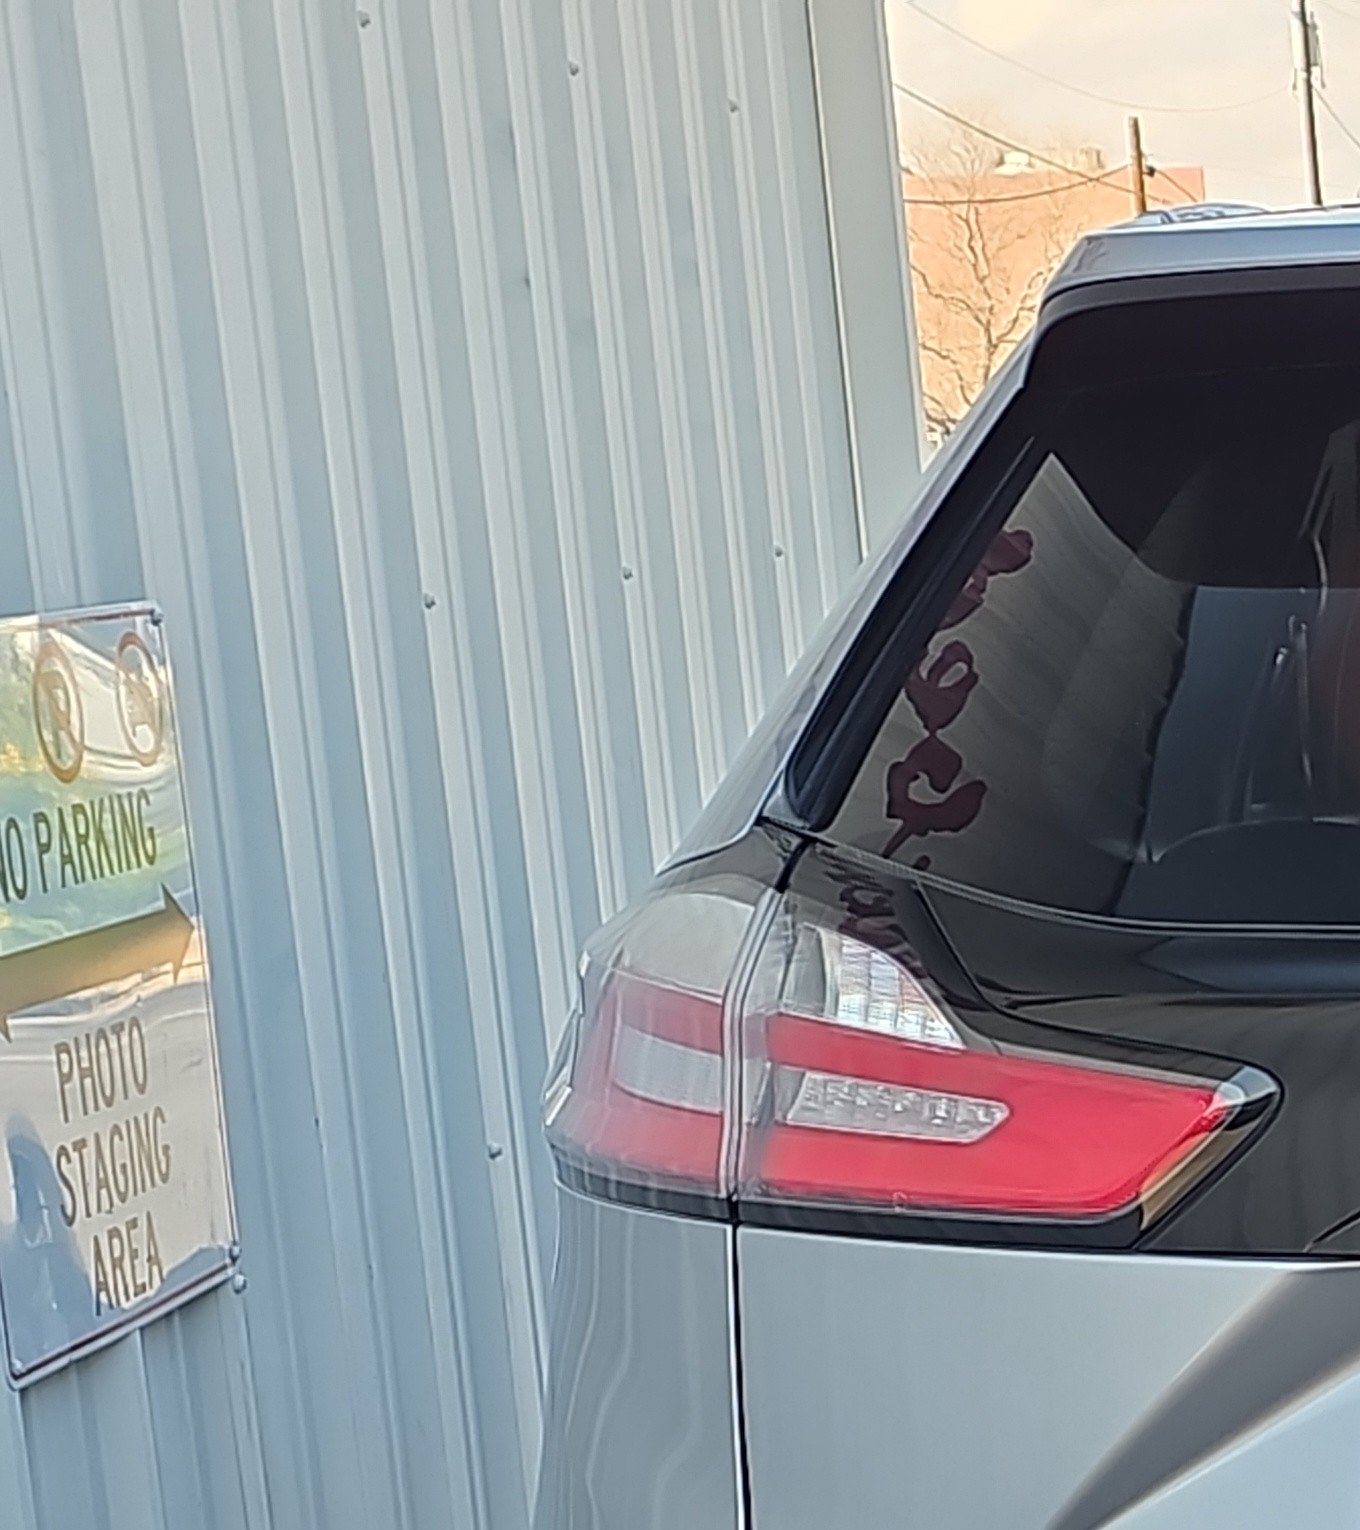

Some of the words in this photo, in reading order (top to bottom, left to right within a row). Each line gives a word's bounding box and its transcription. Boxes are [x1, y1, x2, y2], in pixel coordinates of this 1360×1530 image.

[0, 817, 27, 903] O
[33, 787, 157, 894] PARKING
[54, 1016, 147, 1124] PHOTO
[56, 1106, 171, 1228] STAGING
[92, 1211, 164, 1317] AREA
